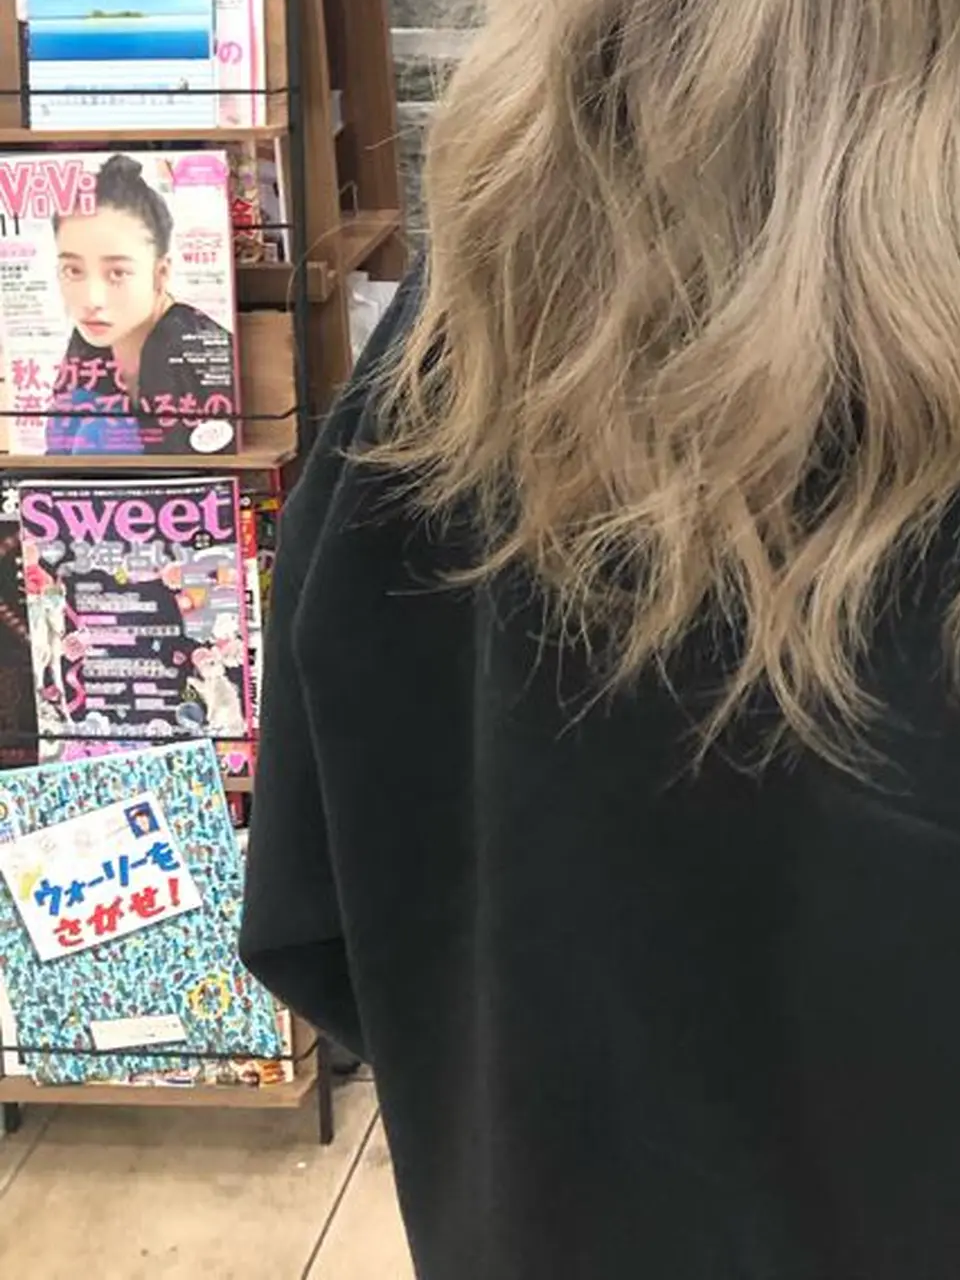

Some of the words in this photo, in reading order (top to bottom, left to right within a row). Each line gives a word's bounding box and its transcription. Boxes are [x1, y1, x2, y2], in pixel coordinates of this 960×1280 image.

[0, 161, 97, 218] ViVi
[34, 841, 181, 916] ウォーリーを
